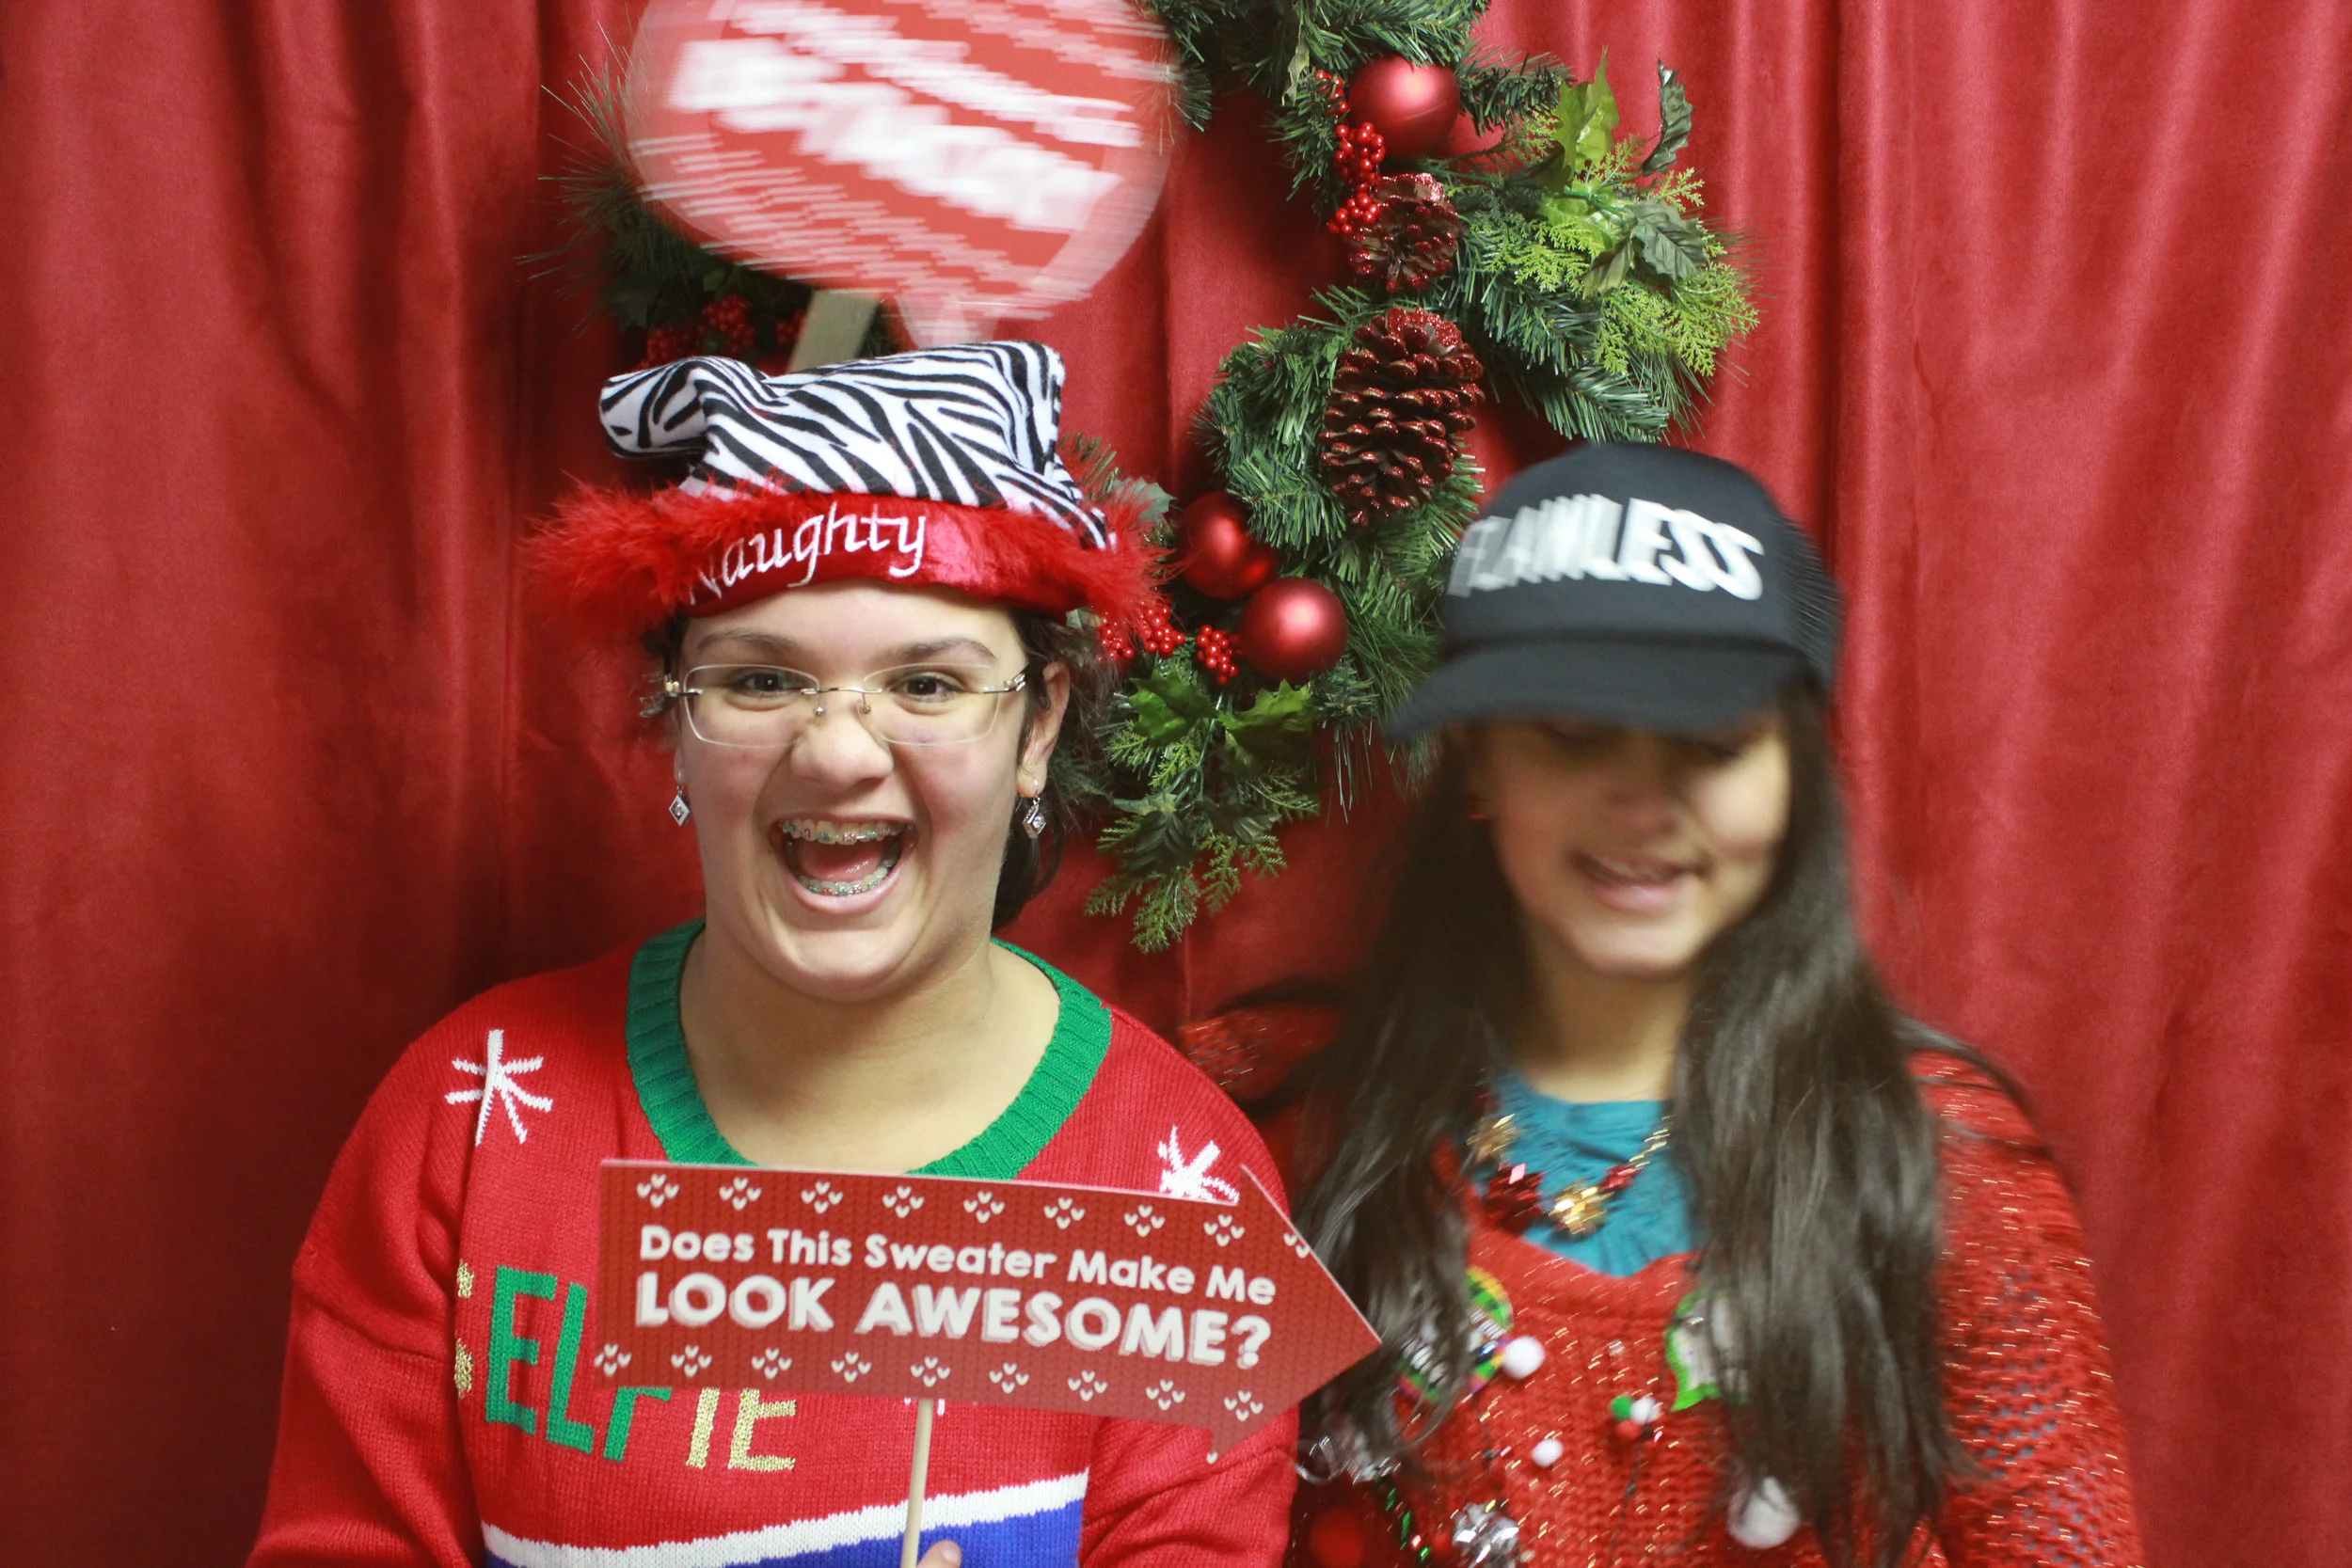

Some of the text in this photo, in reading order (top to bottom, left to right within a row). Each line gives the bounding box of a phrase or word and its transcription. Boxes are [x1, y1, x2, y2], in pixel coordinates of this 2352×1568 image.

[640, 1225, 1277, 1306] Does This Sweater Make Me
[455, 1259, 798, 1472] ELIE
[635, 1271, 1271, 1370] LOOK AWESOME?
